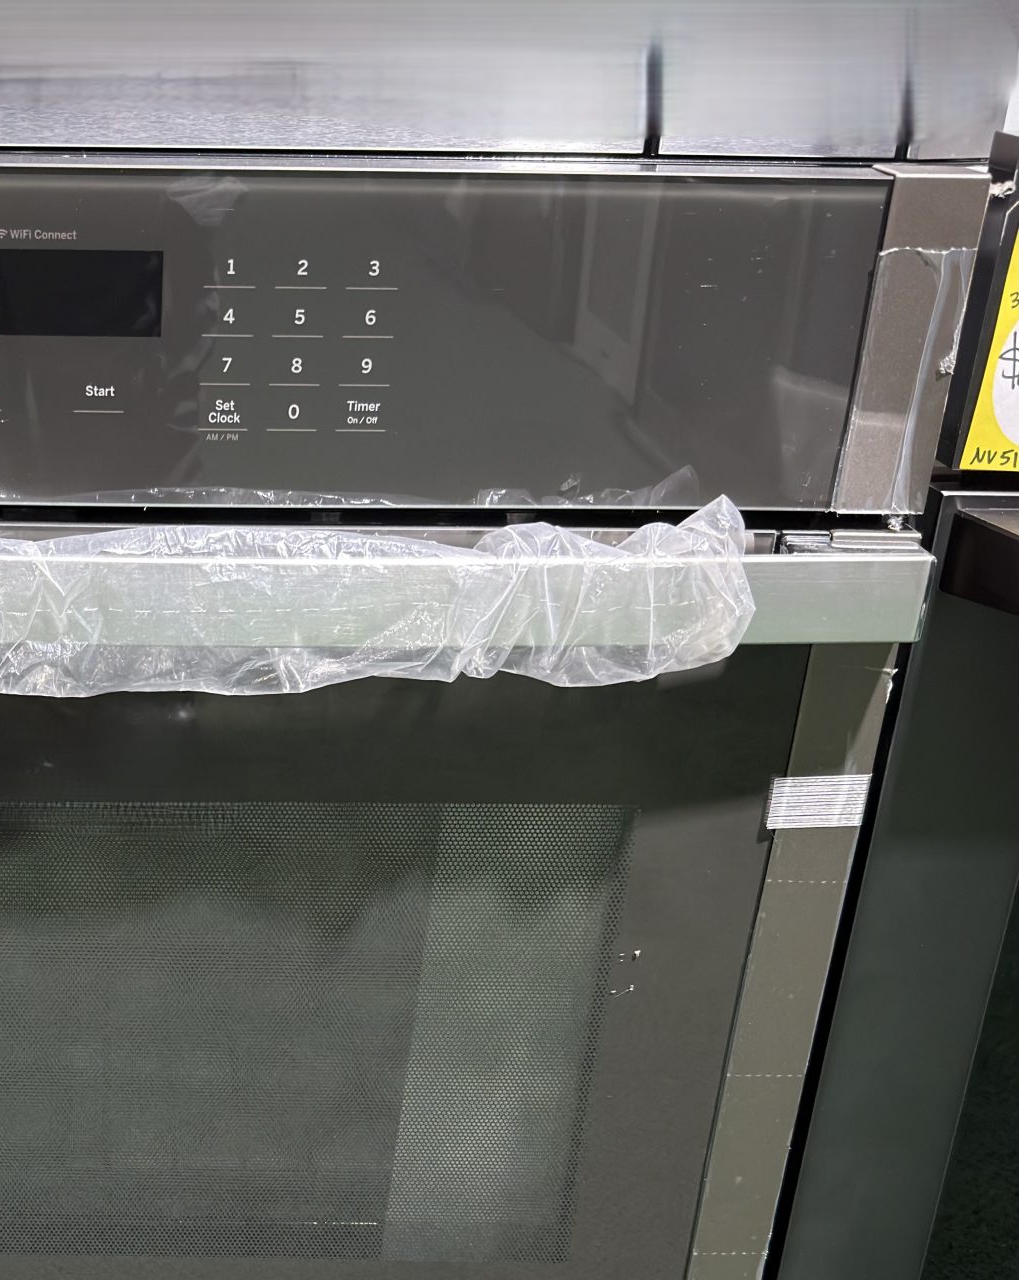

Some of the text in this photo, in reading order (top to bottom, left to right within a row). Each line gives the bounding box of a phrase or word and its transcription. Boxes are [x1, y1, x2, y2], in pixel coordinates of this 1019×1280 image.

[10, 229, 77, 240] WiFi Connect
[227, 259, 236, 275] 1
[297, 259, 309, 276] 2
[368, 260, 380, 276] 3
[223, 308, 235, 324] 4
[294, 309, 306, 325] 5
[365, 310, 376, 325] 6
[222, 358, 232, 373] 7
[291, 358, 302, 374] 8
[361, 359, 373, 374] 9
[85, 385, 115, 397] Start
[215, 400, 235, 411] Set
[288, 404, 300, 420] 0
[347, 401, 380, 412] Timer
[208, 412, 240, 424] Clock
